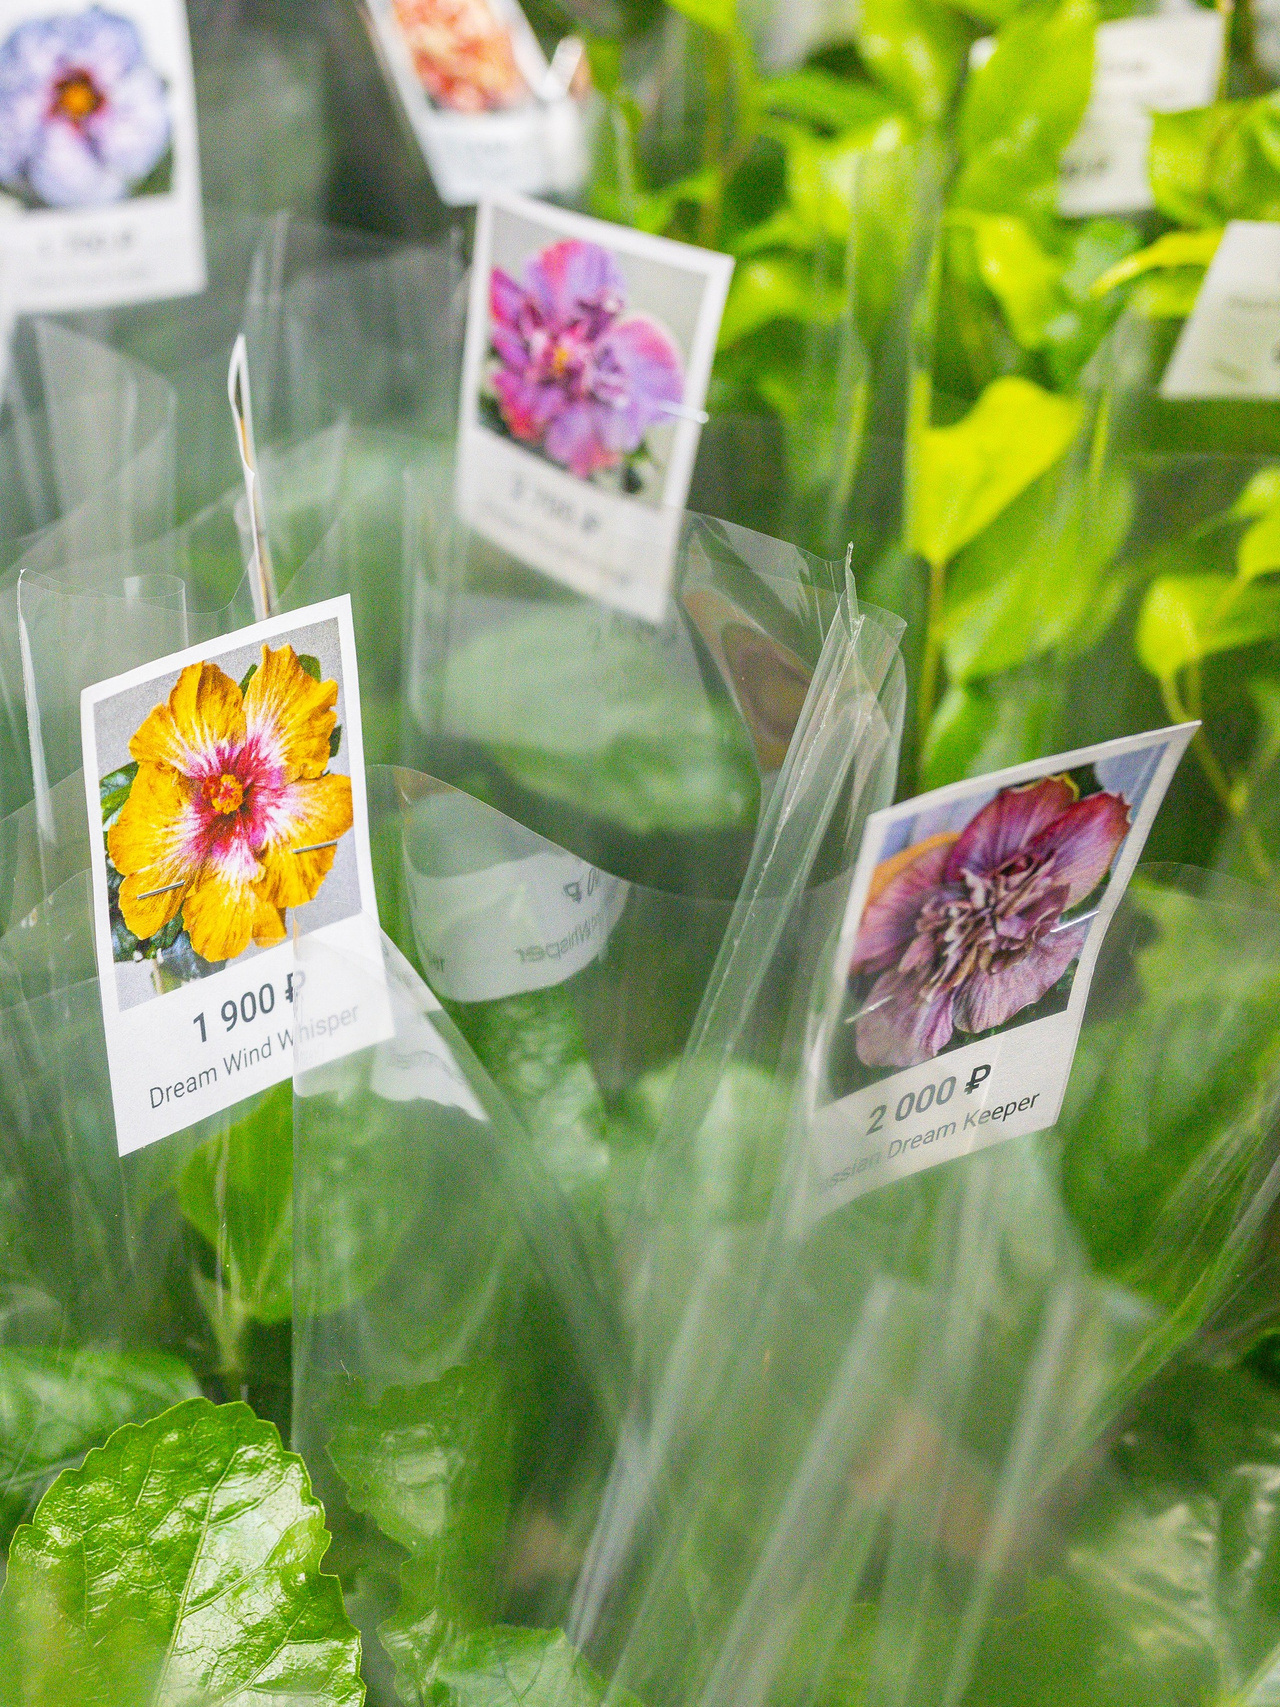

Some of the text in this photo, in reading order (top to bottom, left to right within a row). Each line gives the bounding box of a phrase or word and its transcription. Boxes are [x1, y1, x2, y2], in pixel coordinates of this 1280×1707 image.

[192, 1011, 208, 1043] 1
[220, 982, 276, 1033] 900
[149, 1004, 360, 1109] Dream Wind Whisper
[865, 1063, 992, 1136] 2 000 ₽
[887, 1120, 957, 1159] Dream
[963, 1092, 1041, 1131] Keeper
